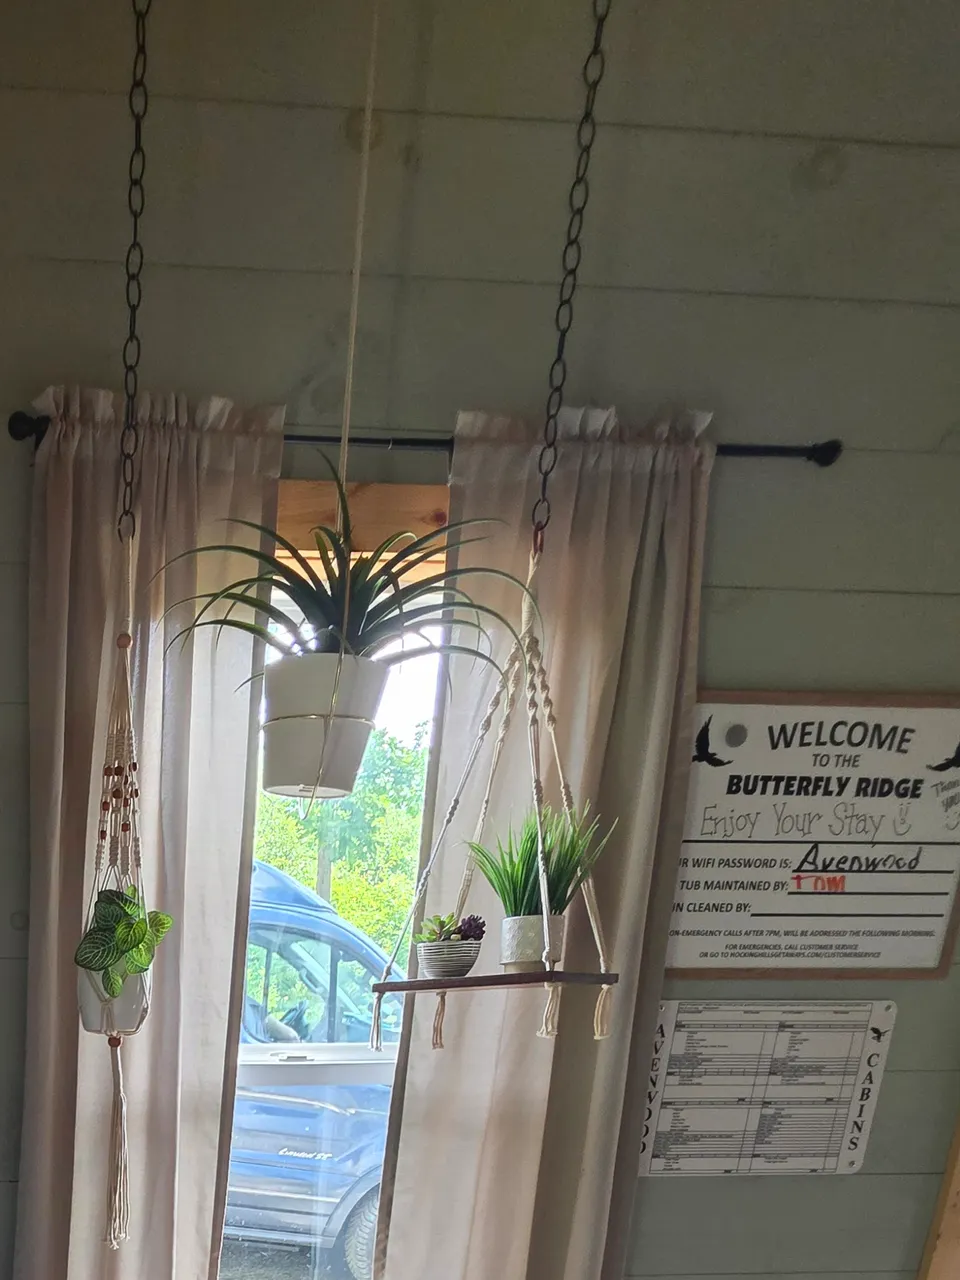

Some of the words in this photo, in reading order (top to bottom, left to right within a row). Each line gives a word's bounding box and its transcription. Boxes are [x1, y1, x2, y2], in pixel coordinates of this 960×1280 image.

[768, 721, 916, 754] WELCOME
[812, 754, 831, 768] TO
[835, 754, 861, 768] THE
[726, 774, 851, 797] BUTTERFLY
[854, 777, 925, 799] RIDGE
[700, 804, 761, 839] Enjoy
[772, 802, 823, 838] Your
[828, 802, 885, 848] Stay
[692, 858, 715, 868] WIFI
[717, 858, 777, 869] PASSWORD
[779, 859, 793, 869] IS:
[680, 880, 701, 891] TUB
[703, 880, 770, 891] MAINTAINED
[773, 880, 789, 891] BY:
[686, 903, 734, 912] CLEANED
[735, 903, 752, 912] BY:
[723, 929, 743, 937] CALLS
[743, 929, 764, 937] AFTER
[848, 1053, 880, 1150] CABINS
